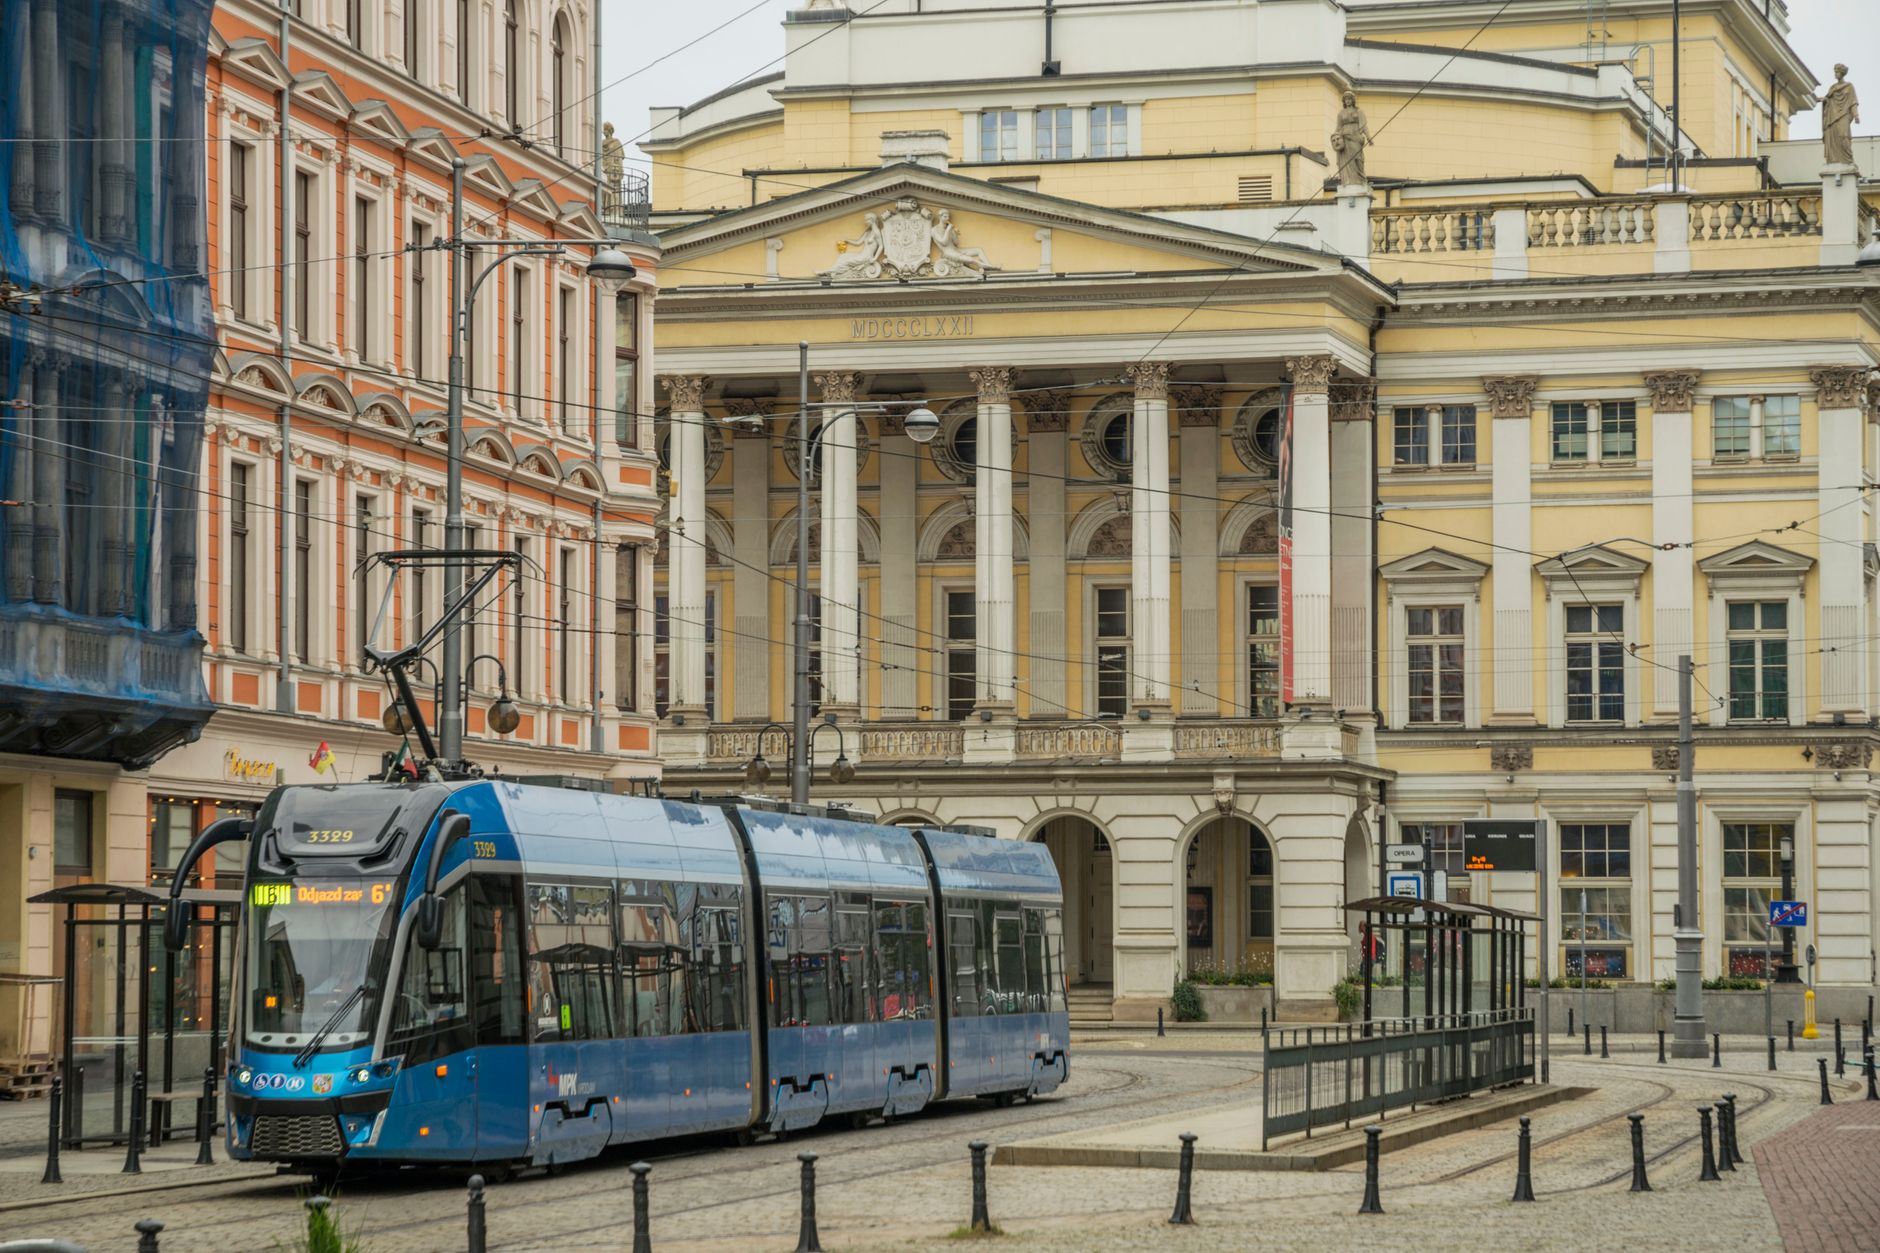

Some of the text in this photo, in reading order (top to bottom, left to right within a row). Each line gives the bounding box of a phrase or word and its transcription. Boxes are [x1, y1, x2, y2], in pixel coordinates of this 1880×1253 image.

[852, 316, 973, 338] MDCCCLXXII
[307, 830, 353, 843] 3329
[473, 841, 496, 858] 3329
[297, 886, 342, 904] Odjazd
[559, 1072, 577, 1097] MPK
